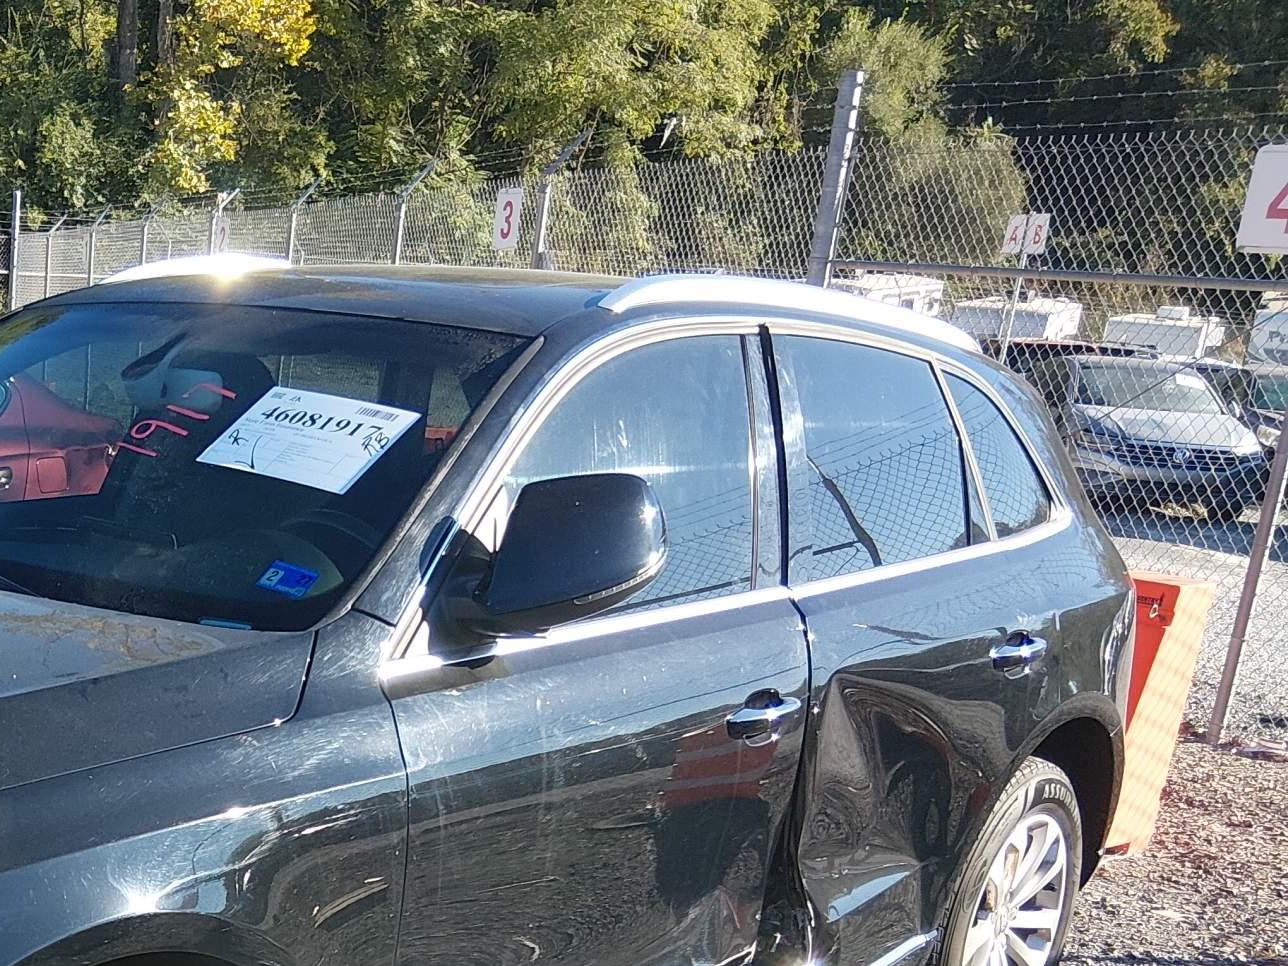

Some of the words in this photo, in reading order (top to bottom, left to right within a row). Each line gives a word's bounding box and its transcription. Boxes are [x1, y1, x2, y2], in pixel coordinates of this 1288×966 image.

[500, 200, 514, 239] 3
[1265, 181, 1288, 234] 4
[1008, 225, 1018, 246] A
[1032, 224, 1043, 245] B
[116, 383, 238, 457] 7917
[261, 406, 383, 440] 46081917
[266, 570, 280, 582] 2
